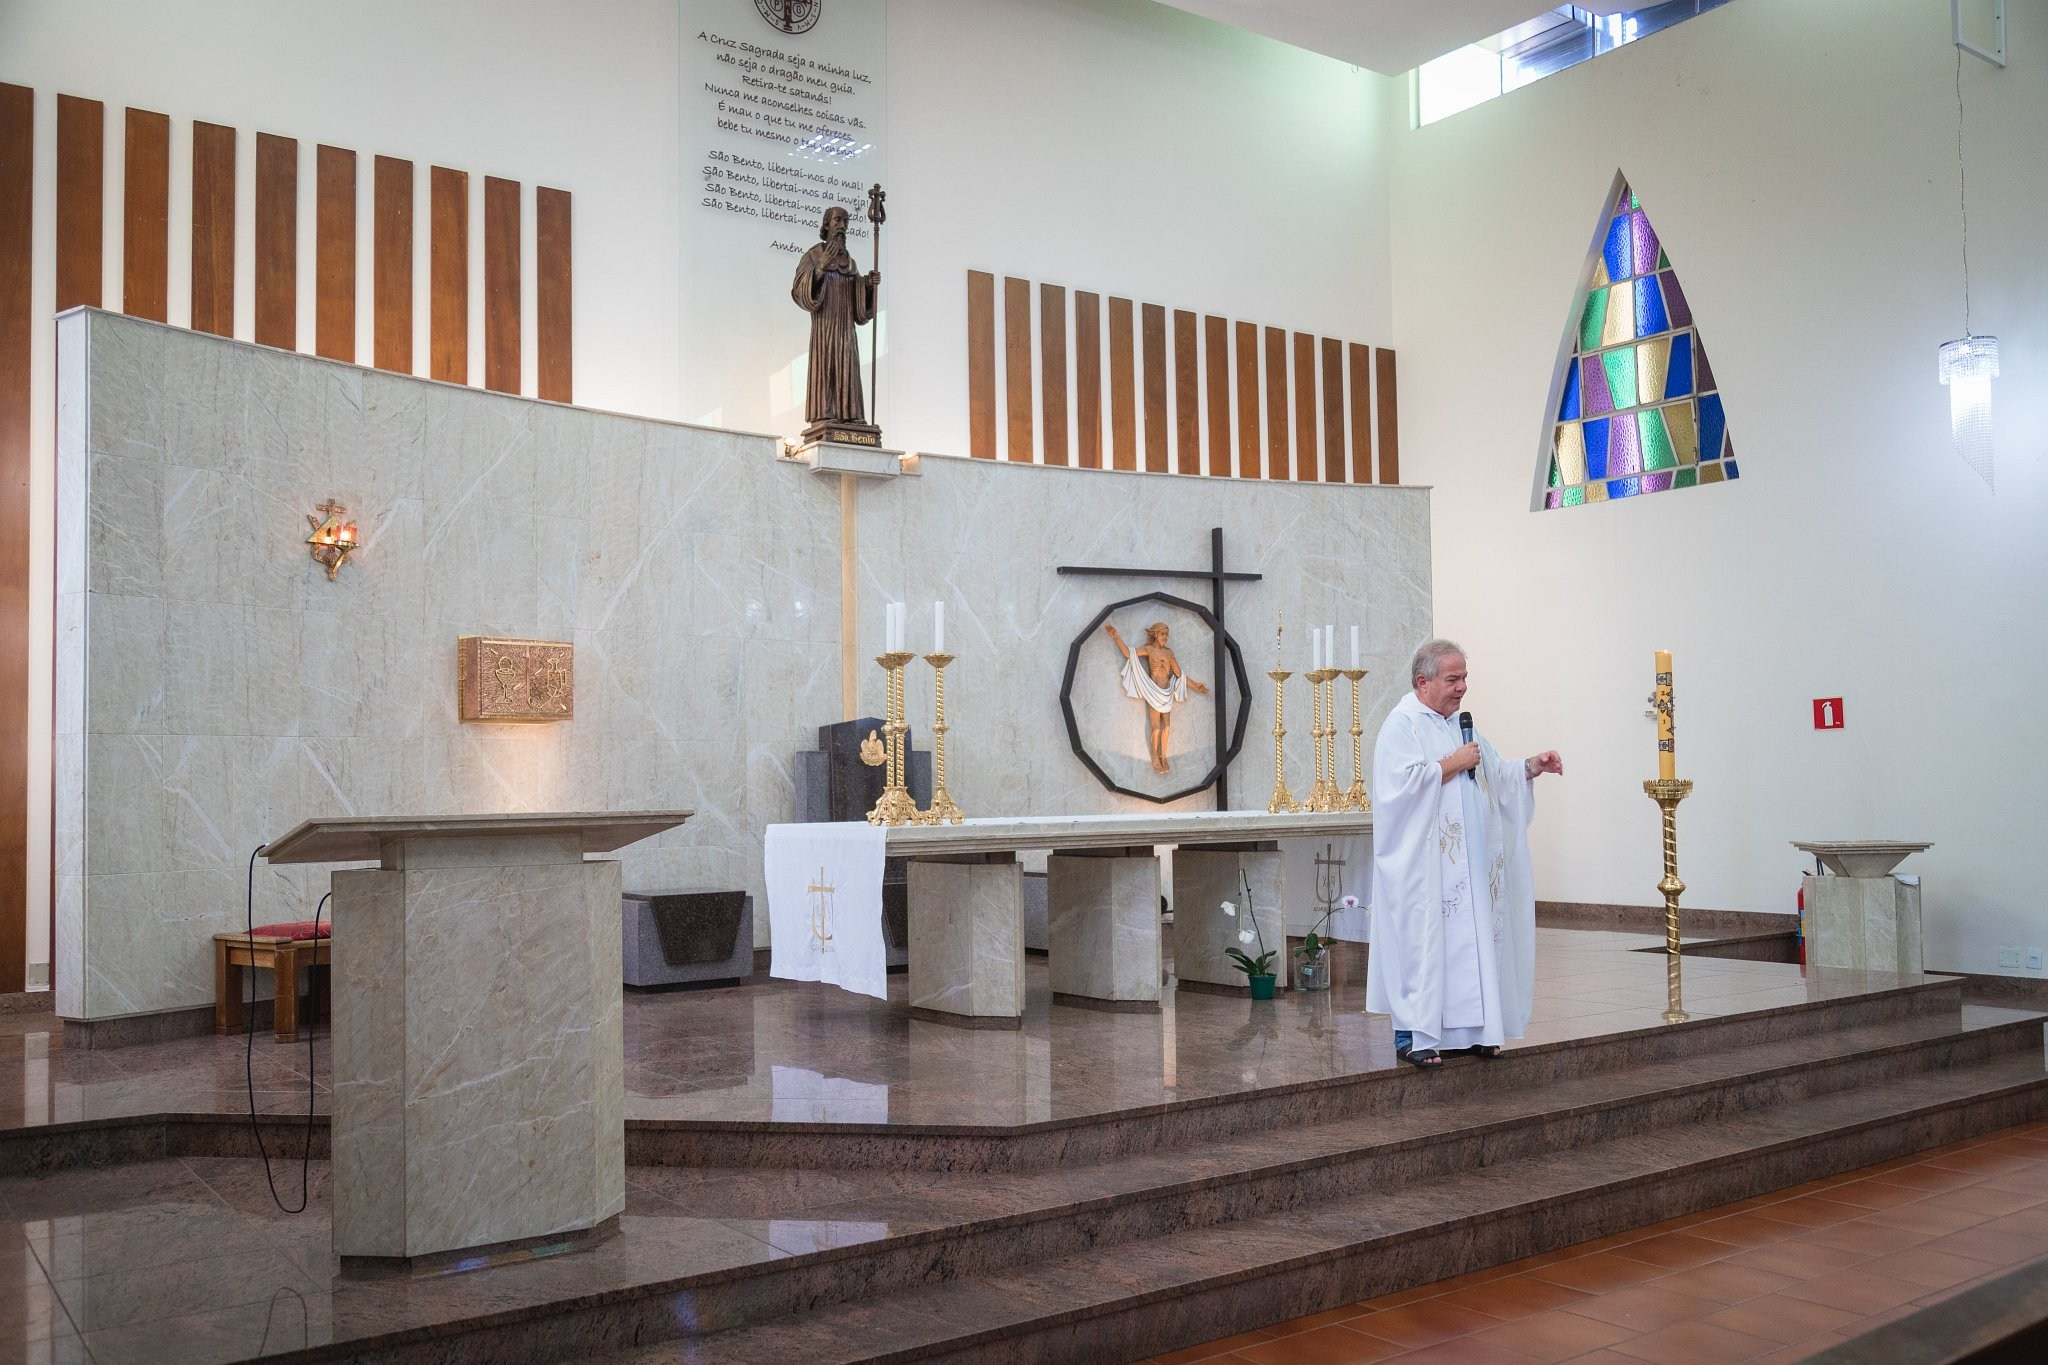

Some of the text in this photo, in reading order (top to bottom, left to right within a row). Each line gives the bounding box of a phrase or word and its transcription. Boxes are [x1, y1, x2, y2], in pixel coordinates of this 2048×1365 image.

[698, 31, 872, 84] A Cruz Sagrada seja a minha luz,
[716, 53, 856, 96] não seja o dragão meu guia.
[704, 82, 867, 129] Nunca me aconselhes coisas vãs.
[742, 75, 832, 105] Retira-te satanás!
[717, 116, 739, 132] bebe
[740, 123, 753, 135] tu
[755, 128, 791, 144] mesmo
[793, 137, 799, 145] o
[718, 99, 726, 111] É
[728, 105, 753, 118] mau
[755, 112, 761, 120] o
[763, 114, 782, 127] que
[784, 116, 796, 128] tu
[799, 121, 814, 132] me
[702, 165, 869, 212] São Bento, libertai-nos da inveja!
[708, 150, 864, 192] São Bento, libertai-nos do mal!
[701, 197, 723, 210] São
[725, 200, 759, 217] Bento,
[761, 207, 819, 229] libertai-nos
[704, 182, 868, 224] São Bento, libertai-nos edo!
